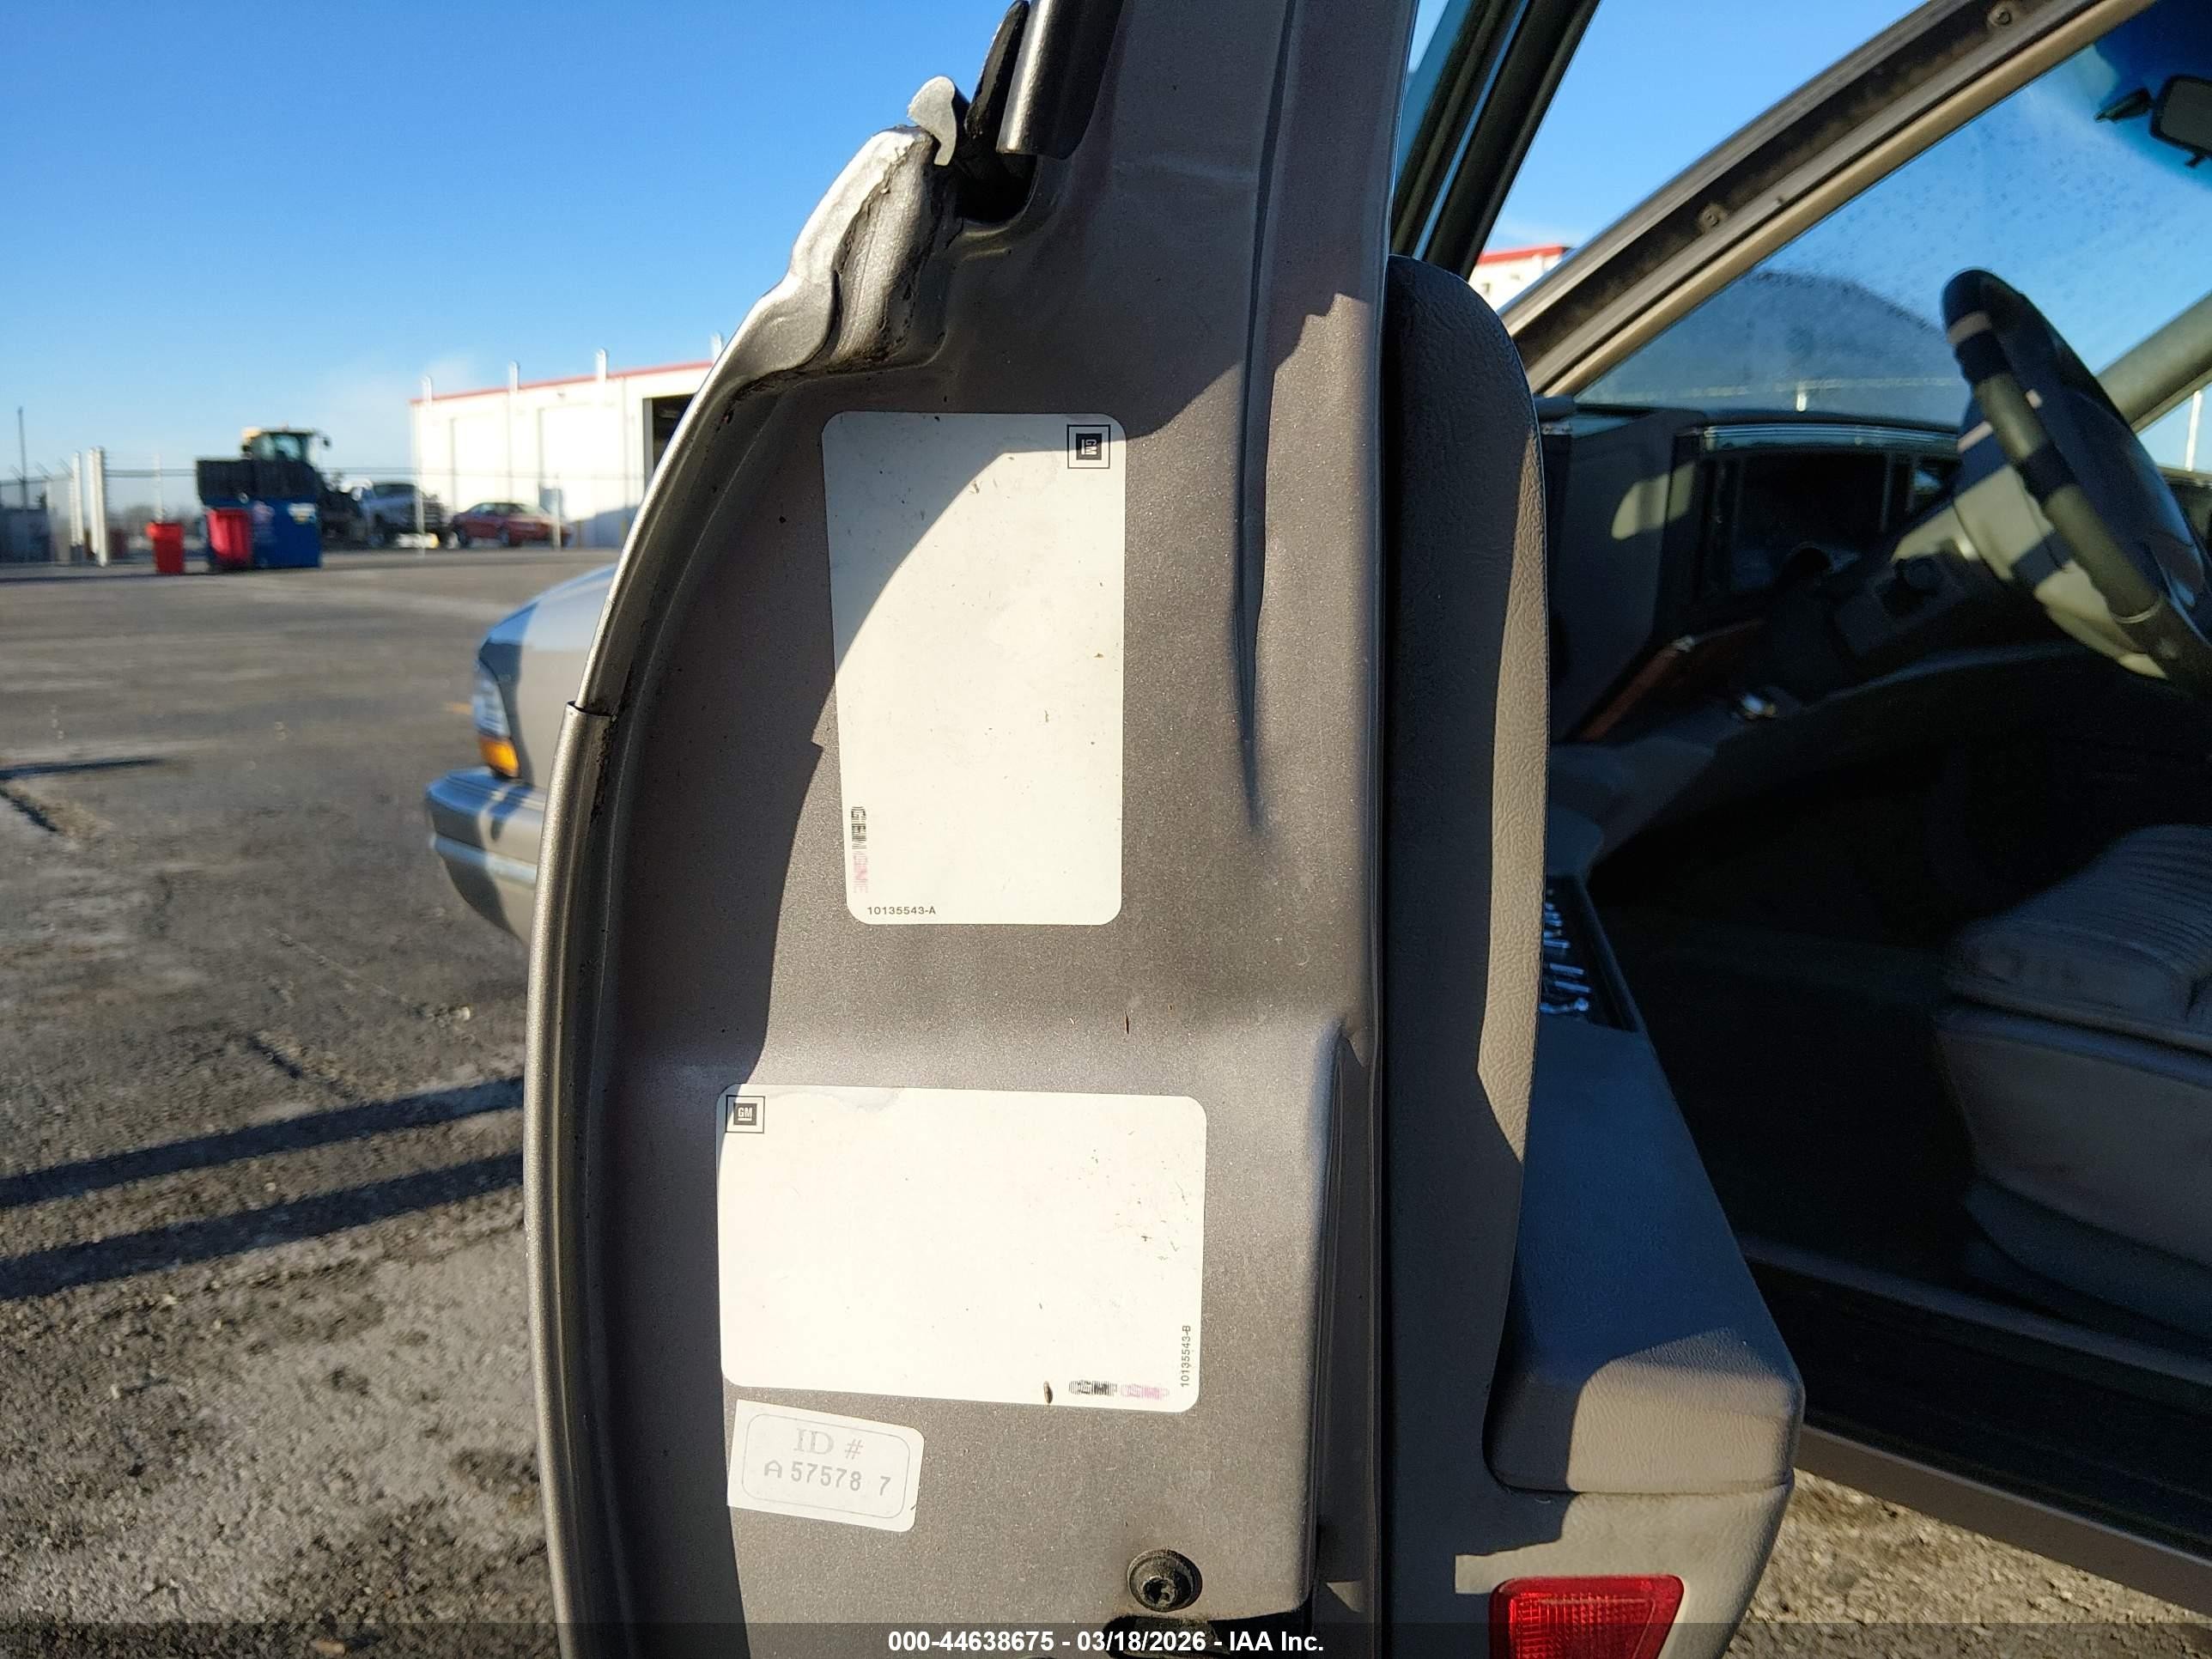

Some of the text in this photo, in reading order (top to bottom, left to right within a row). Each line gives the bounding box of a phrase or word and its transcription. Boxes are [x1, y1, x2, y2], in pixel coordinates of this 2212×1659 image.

[866, 906, 937, 915] 10135543-A
[1180, 1325, 1192, 1388] 10135543-B
[793, 1428, 835, 1455] ID
[790, 1461, 862, 1492] 57578
[878, 1475, 892, 1497] 7
